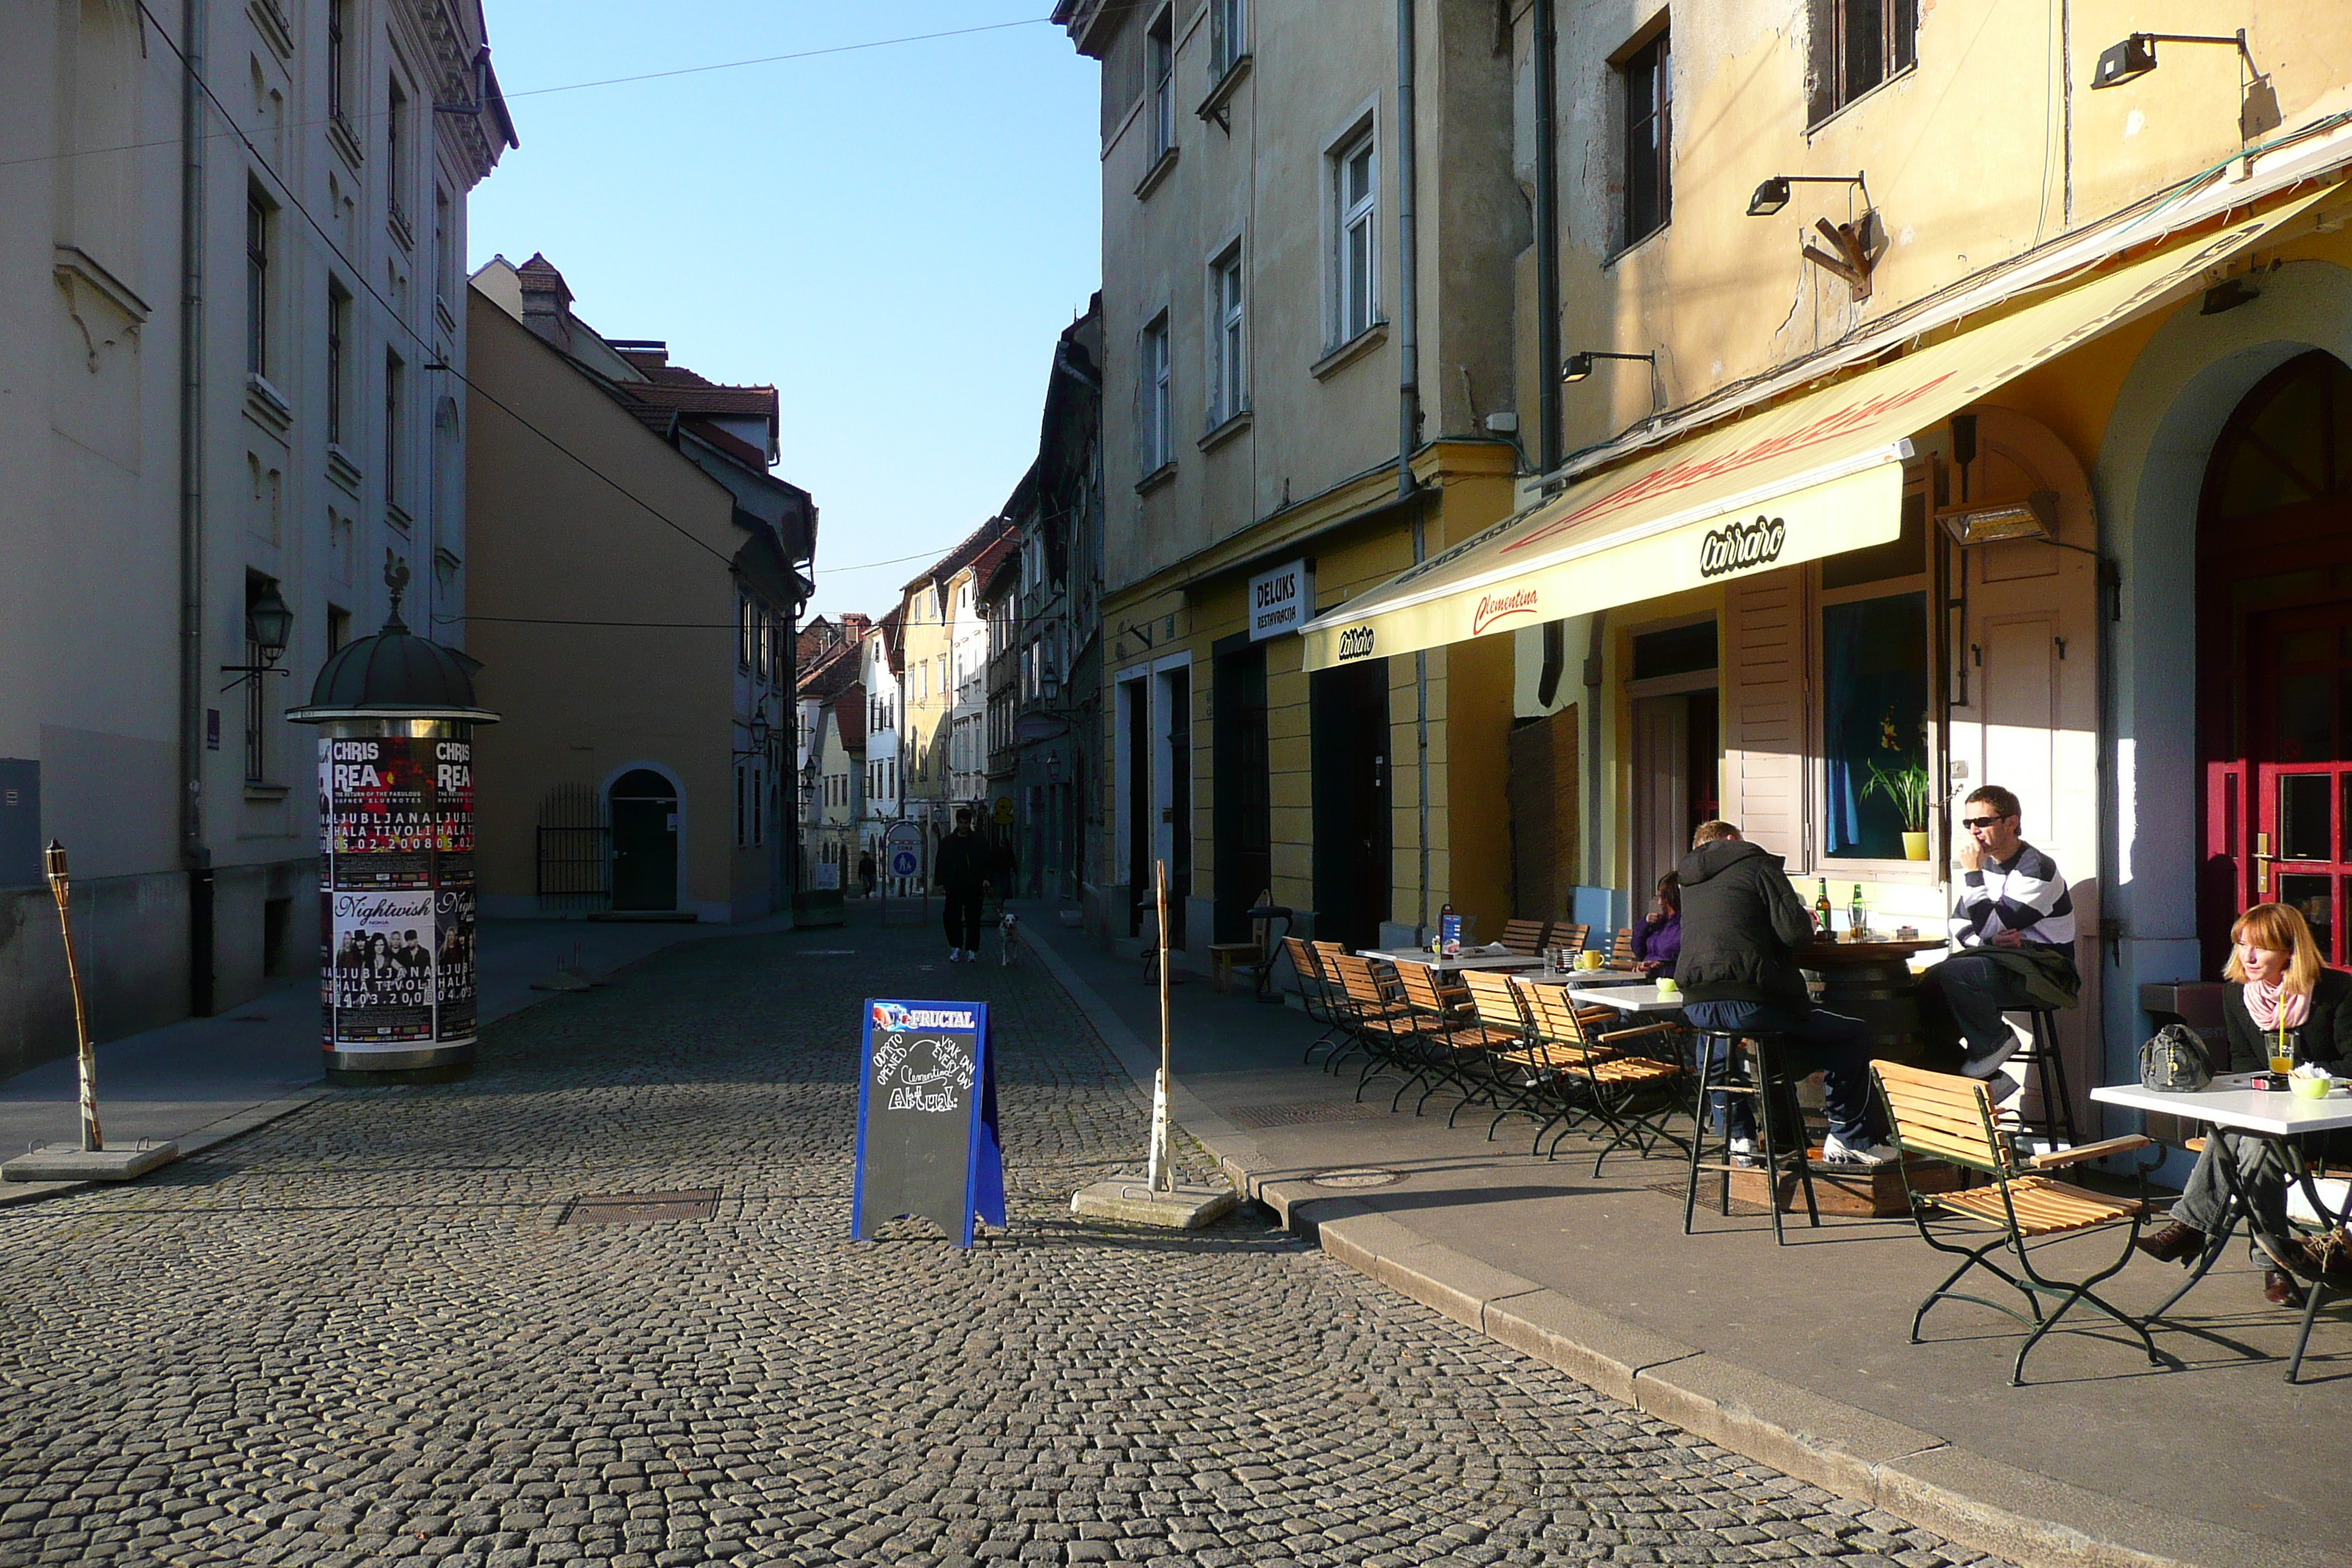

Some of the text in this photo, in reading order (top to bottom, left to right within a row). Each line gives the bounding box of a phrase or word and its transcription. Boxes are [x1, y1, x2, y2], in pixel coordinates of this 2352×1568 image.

[1700, 515, 1786, 578] Carraro
[1257, 573, 1295, 608] DELUKS
[1257, 606, 1296, 630] RESTAVRACIJA
[1474, 589, 1538, 636] Clementina
[1339, 626, 1374, 660] Carraro
[333, 742, 379, 761] CHRIS
[437, 742, 470, 763] CHRIS
[334, 765, 381, 792] REA
[438, 764, 470, 791] REA
[333, 813, 431, 823] LJUBLJANA
[334, 826, 366, 837] HALA
[375, 826, 431, 837] TIVOLI
[437, 825, 465, 836] HALA
[334, 838, 431, 849] 05.02.2008
[335, 895, 431, 926] Nightwish
[335, 966, 431, 979] LJUBLJANA
[438, 975, 467, 989] HALA
[336, 981, 368, 992] HALA
[375, 979, 431, 992] TIVOLI
[335, 990, 433, 1005] 04.03.2008
[911, 1010, 975, 1028] FRUCTAL
[873, 1033, 902, 1068] ODPRTO
[941, 1035, 976, 1075] VSAK DAN
[878, 1048, 907, 1085] OPENED
[901, 1065, 953, 1086] Clementina
[932, 1046, 974, 1090] EVERY DAY
